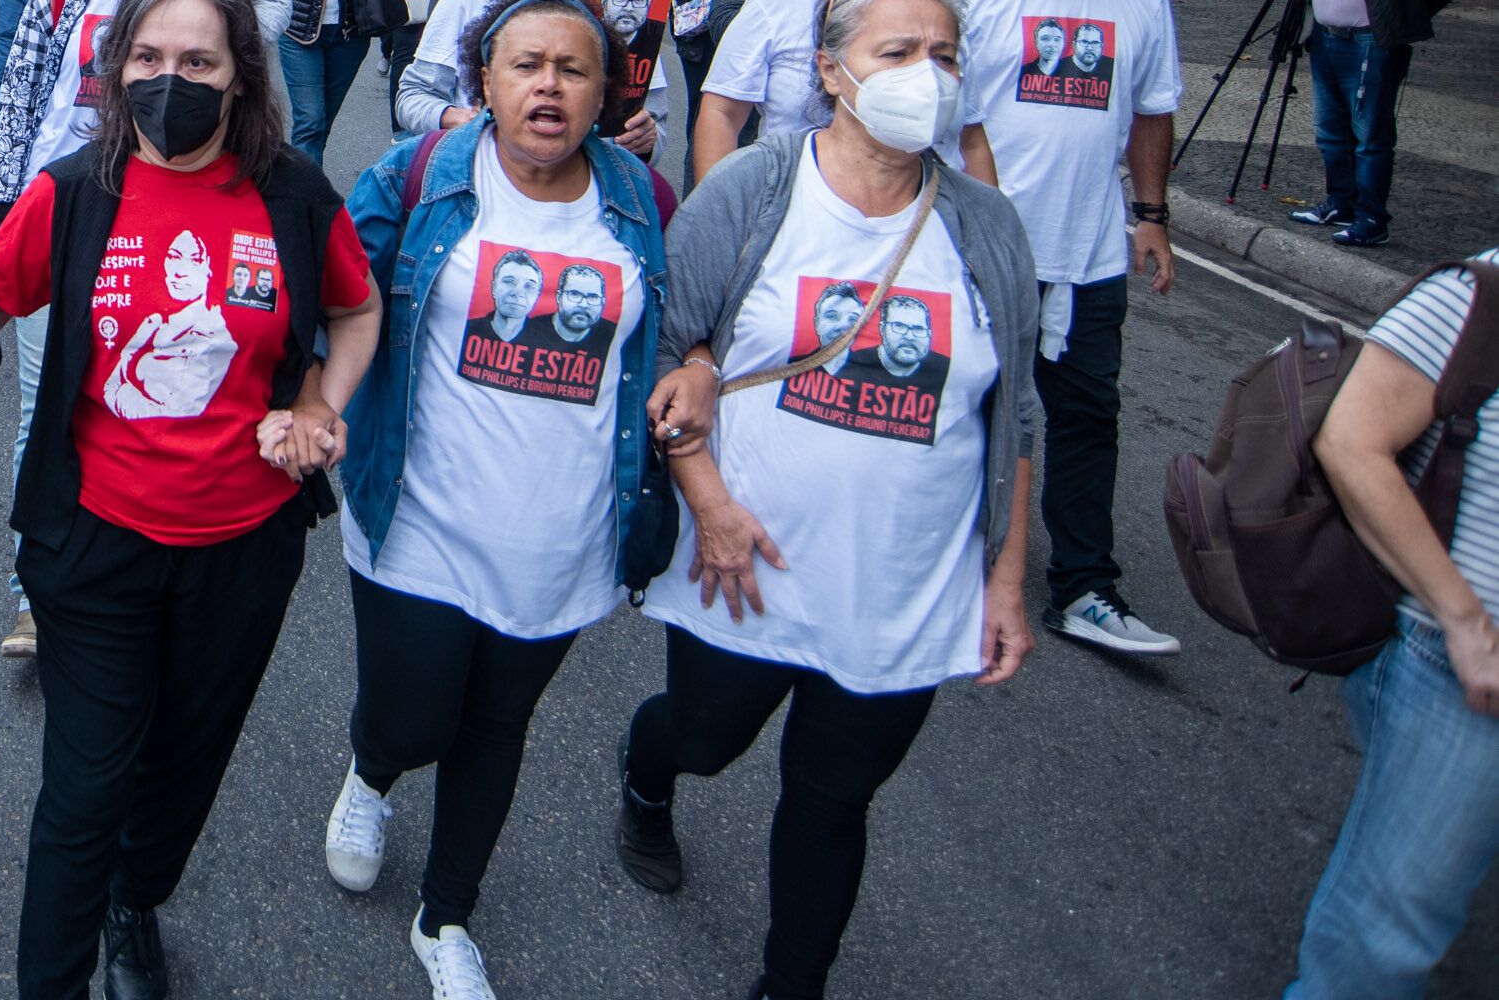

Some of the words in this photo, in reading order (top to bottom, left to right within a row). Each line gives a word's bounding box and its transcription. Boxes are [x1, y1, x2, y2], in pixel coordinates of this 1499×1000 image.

[1021, 74, 1060, 93] ONDE
[1064, 76, 1109, 99] ESTÃO
[107, 236, 143, 251] RIELLE
[233, 233, 254, 247] ONDE
[95, 275, 117, 289] OJE
[124, 274, 131, 288] E
[91, 293, 132, 308] EMPRE
[465, 335, 529, 374] ONDE
[530, 350, 600, 385] ESTÃO
[462, 364, 481, 379] DOM
[482, 369, 519, 388] PHILLIPS
[520, 379, 526, 390] E
[527, 379, 556, 395] BRUNO
[557, 384, 595, 399] PEREIRA?
[788, 370, 854, 409] ONDE
[857, 382, 935, 424] ESTÃO
[784, 394, 803, 411] DOM
[805, 402, 845, 424] PHILLIPS
[846, 414, 854, 426] E
[854, 416, 886, 433] BRUNO
[888, 421, 931, 439] PEREIRA?
